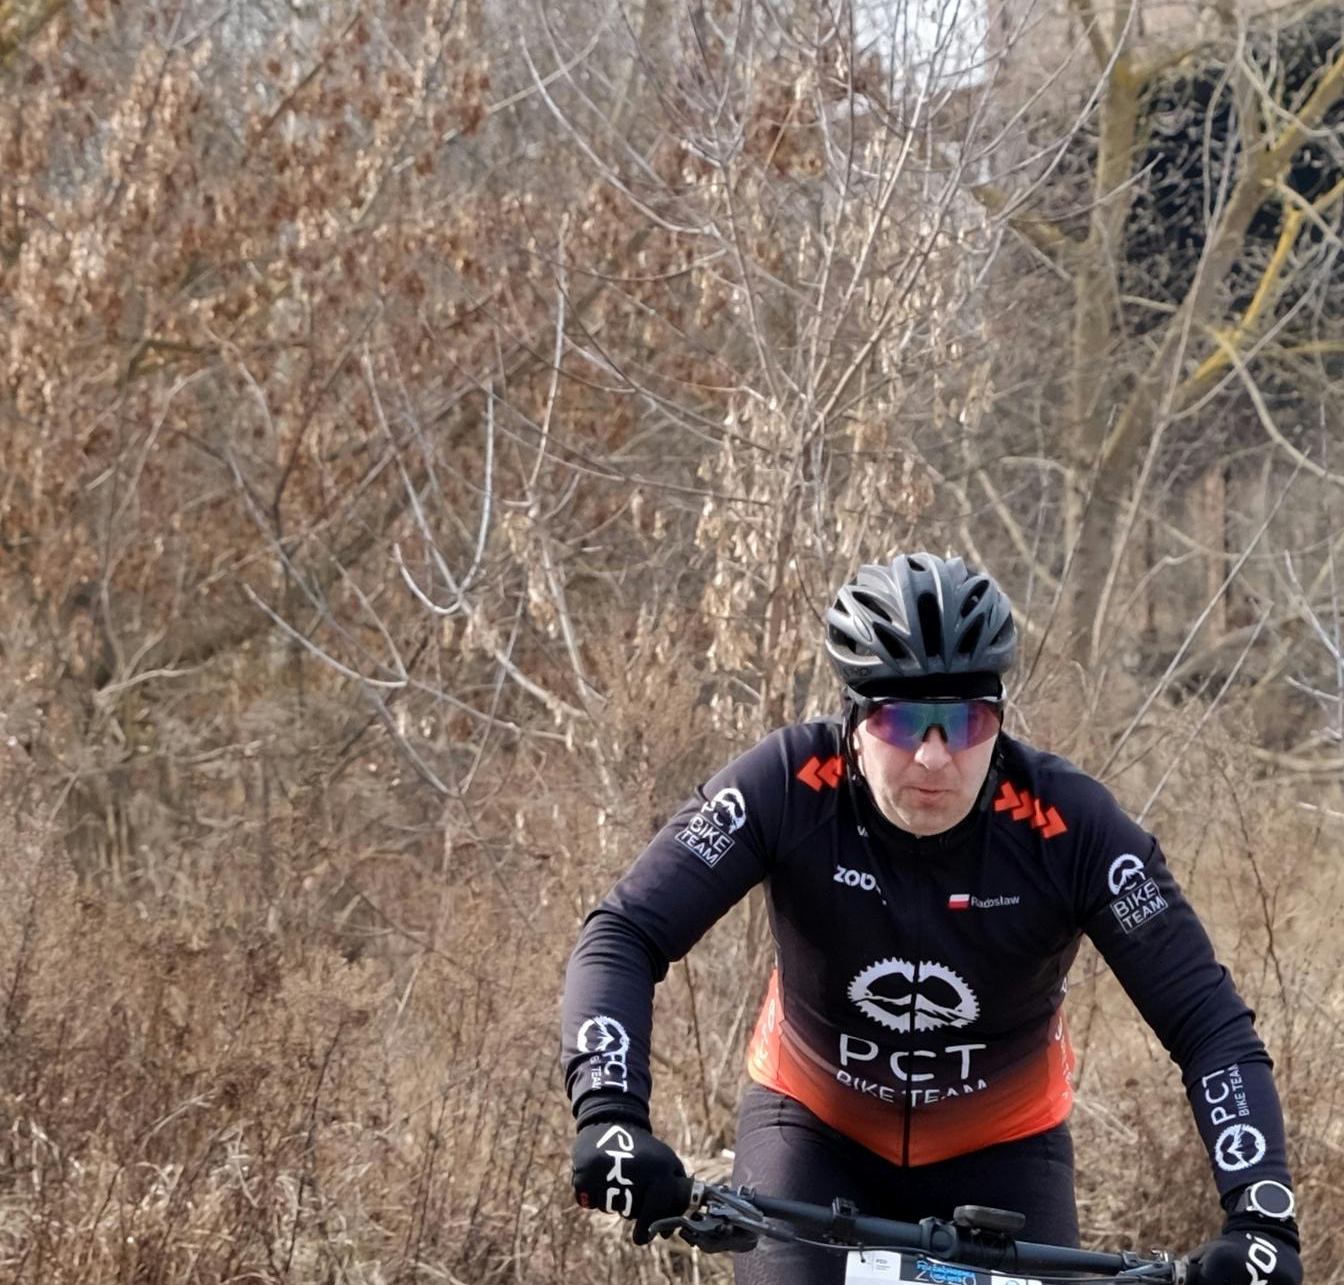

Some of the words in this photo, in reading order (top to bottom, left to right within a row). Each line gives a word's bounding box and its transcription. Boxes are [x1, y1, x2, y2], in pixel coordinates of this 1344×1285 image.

[680, 830, 719, 864] TEAM
[690, 816, 731, 854] BIKE
[1114, 881, 1157, 917] BIKE
[1122, 896, 1166, 928] TEAM
[839, 1033, 988, 1082] PCT
[836, 1069, 896, 1103] BIKE
[1233, 1091, 1250, 1116] BIKE
